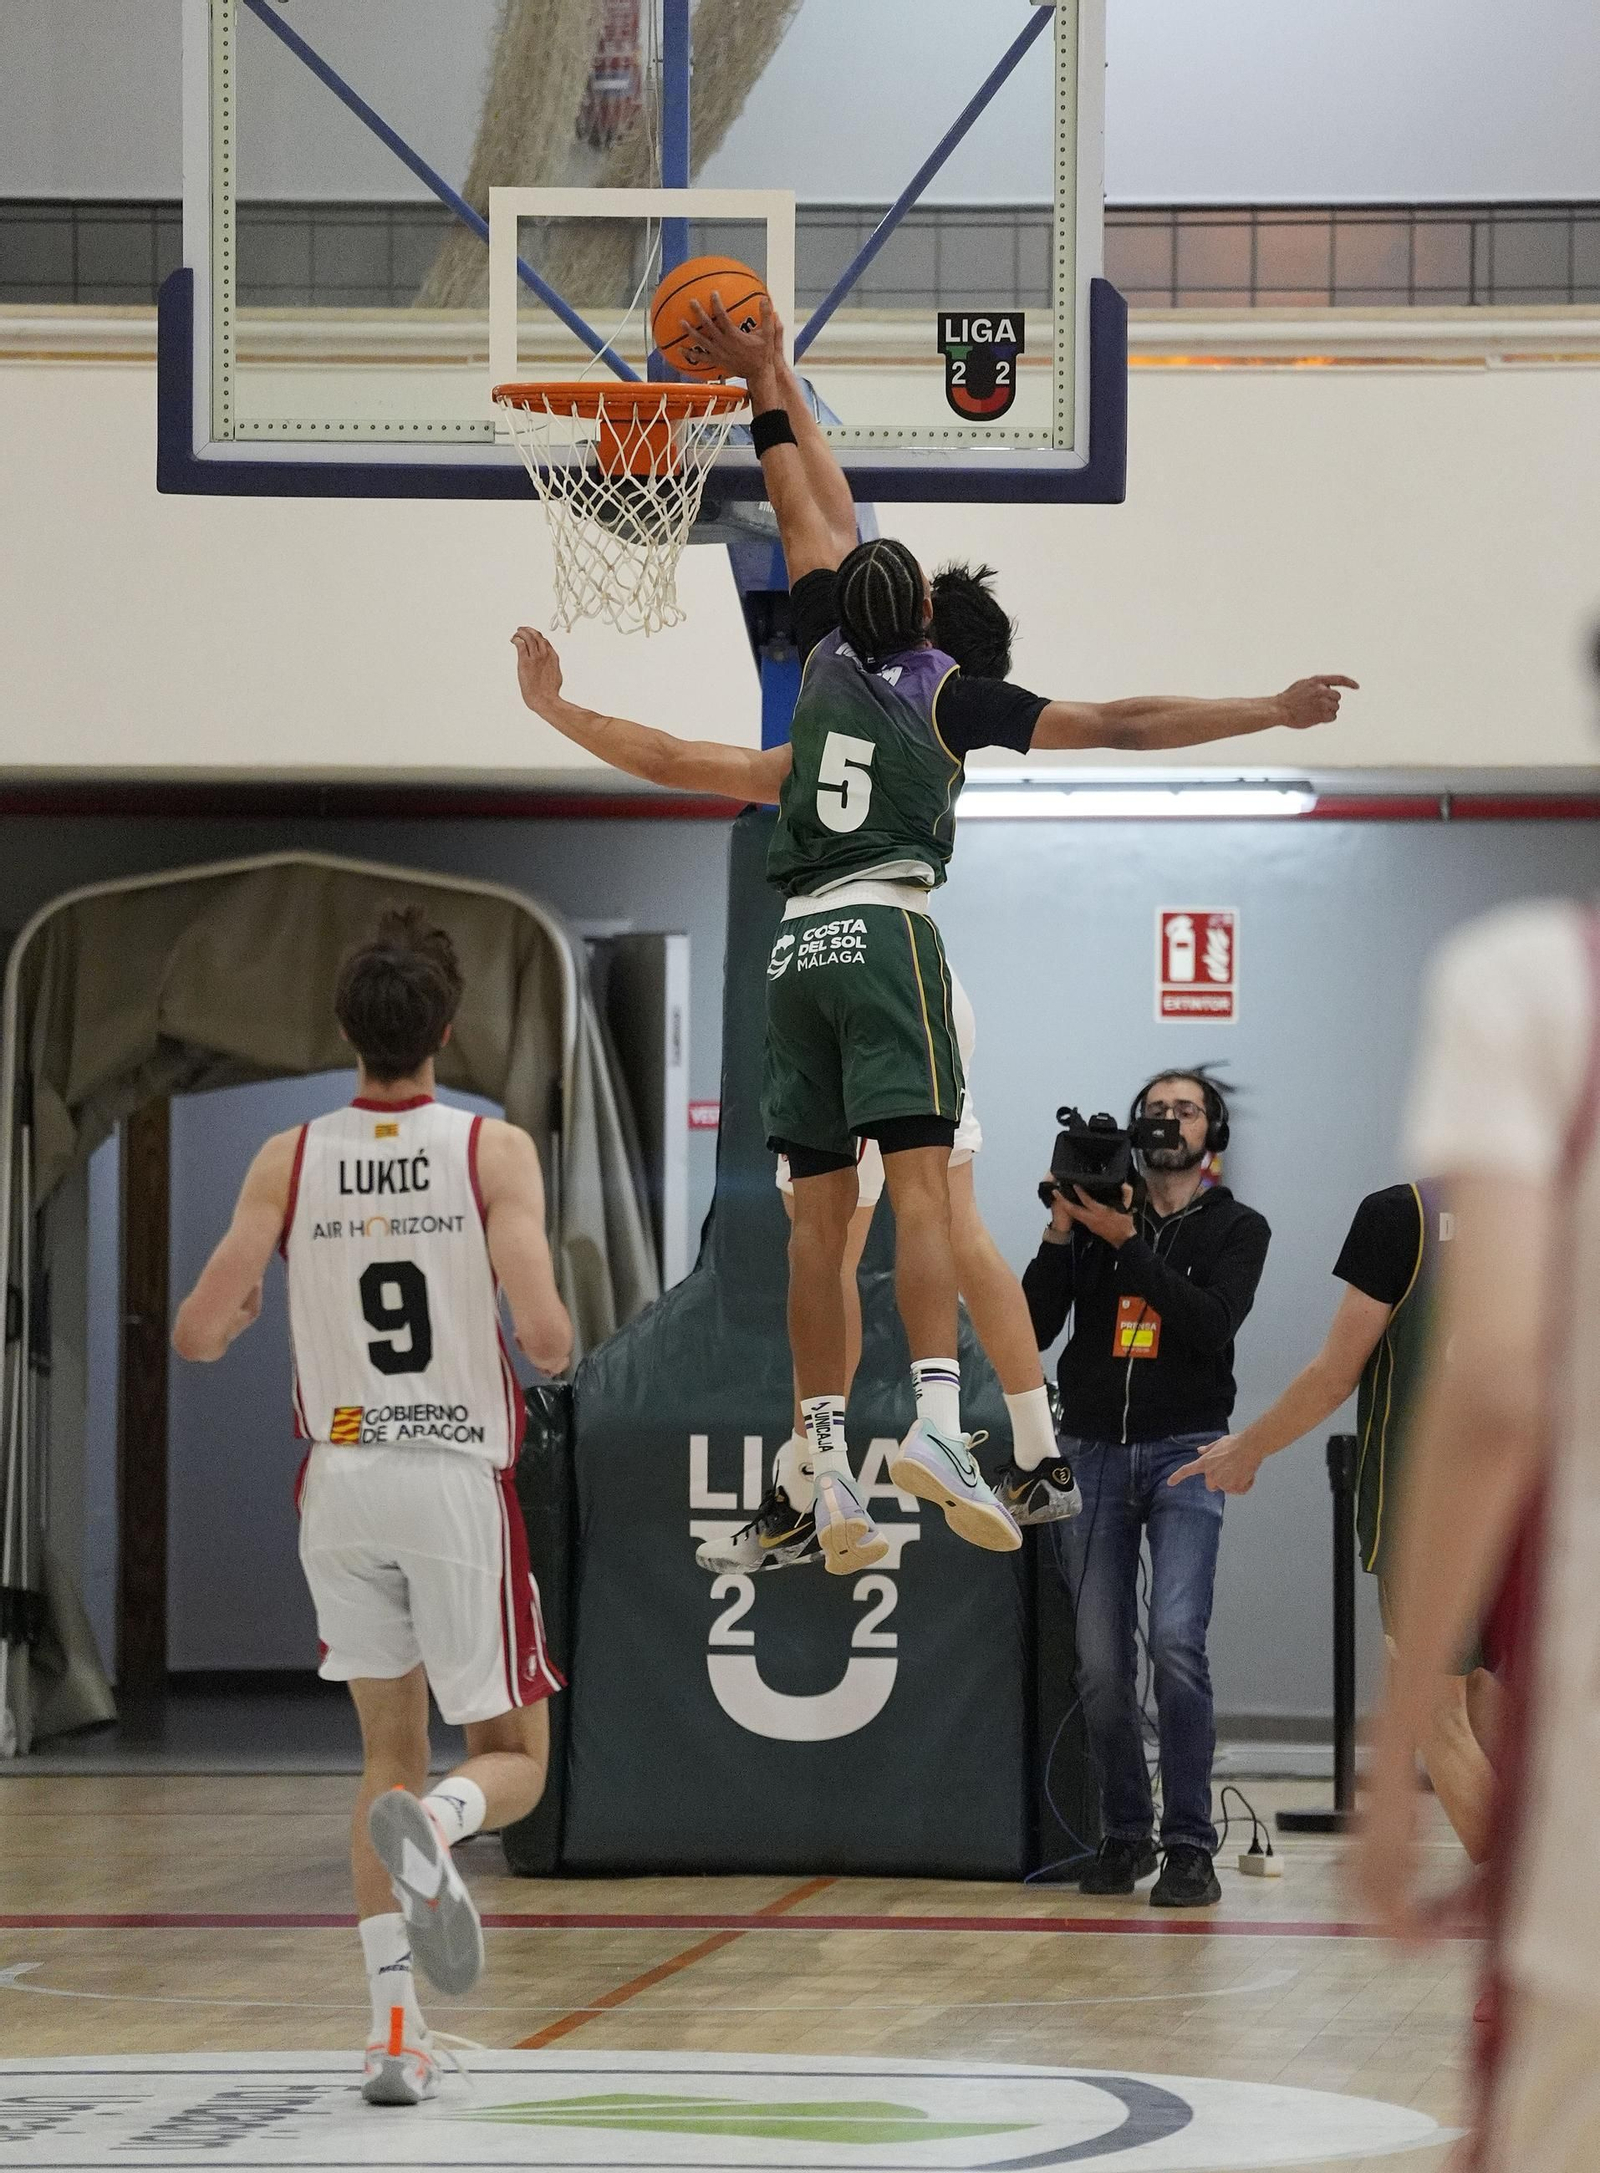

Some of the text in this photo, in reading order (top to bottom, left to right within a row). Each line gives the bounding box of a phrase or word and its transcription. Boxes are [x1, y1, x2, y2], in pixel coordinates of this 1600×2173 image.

[945, 318, 1017, 343] LIGA
[816, 731, 876, 833] 5
[798, 928, 867, 957] DEL SOL
[802, 918, 868, 942] COSTA
[797, 950, 866, 972] MÁLAGA
[340, 1148, 430, 1195] LUKIĆ
[312, 1215, 465, 1240] AIR HORIZONT
[359, 1261, 433, 1376] 9
[365, 1404, 469, 1426] GOBIERNO
[362, 1426, 388, 1444] DE
[814, 1411, 834, 1453] UNICAJA
[690, 1434, 921, 1513] LIA
[708, 1574, 899, 1648] 2 2
